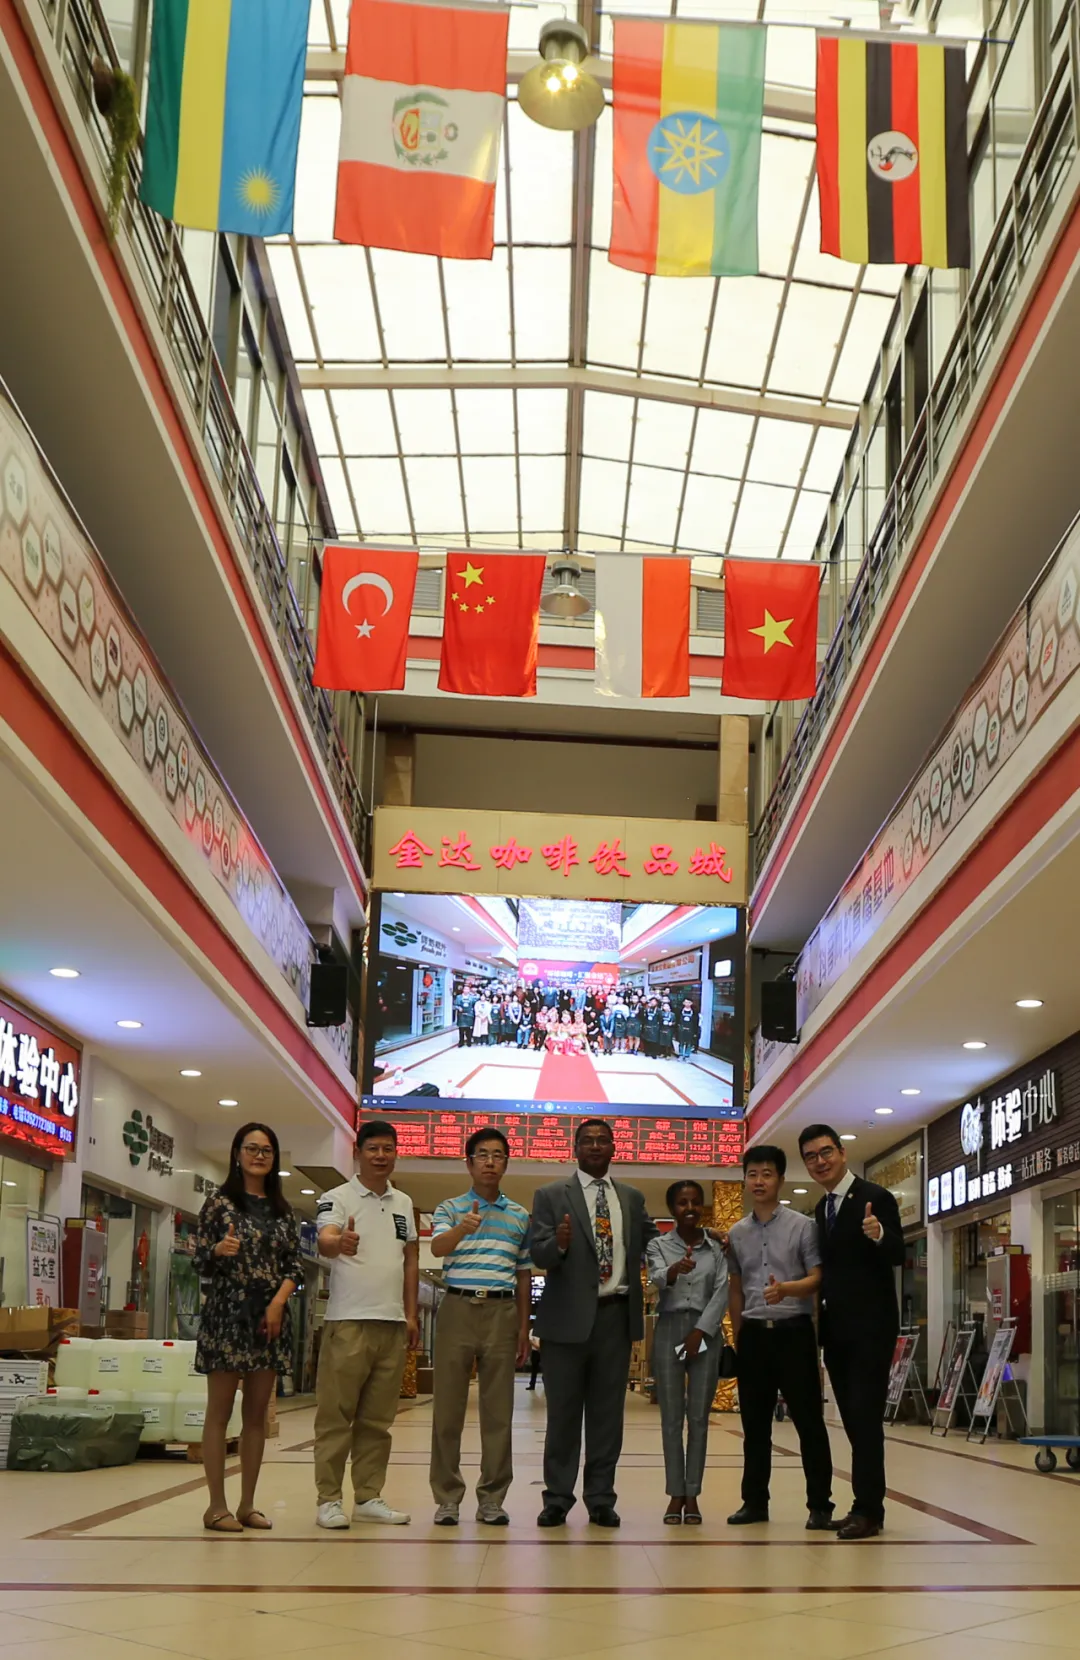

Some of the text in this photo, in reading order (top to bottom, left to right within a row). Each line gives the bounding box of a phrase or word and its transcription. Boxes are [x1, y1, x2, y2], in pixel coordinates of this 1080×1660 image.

[388, 828, 733, 884] 金达咖啡饮品城
